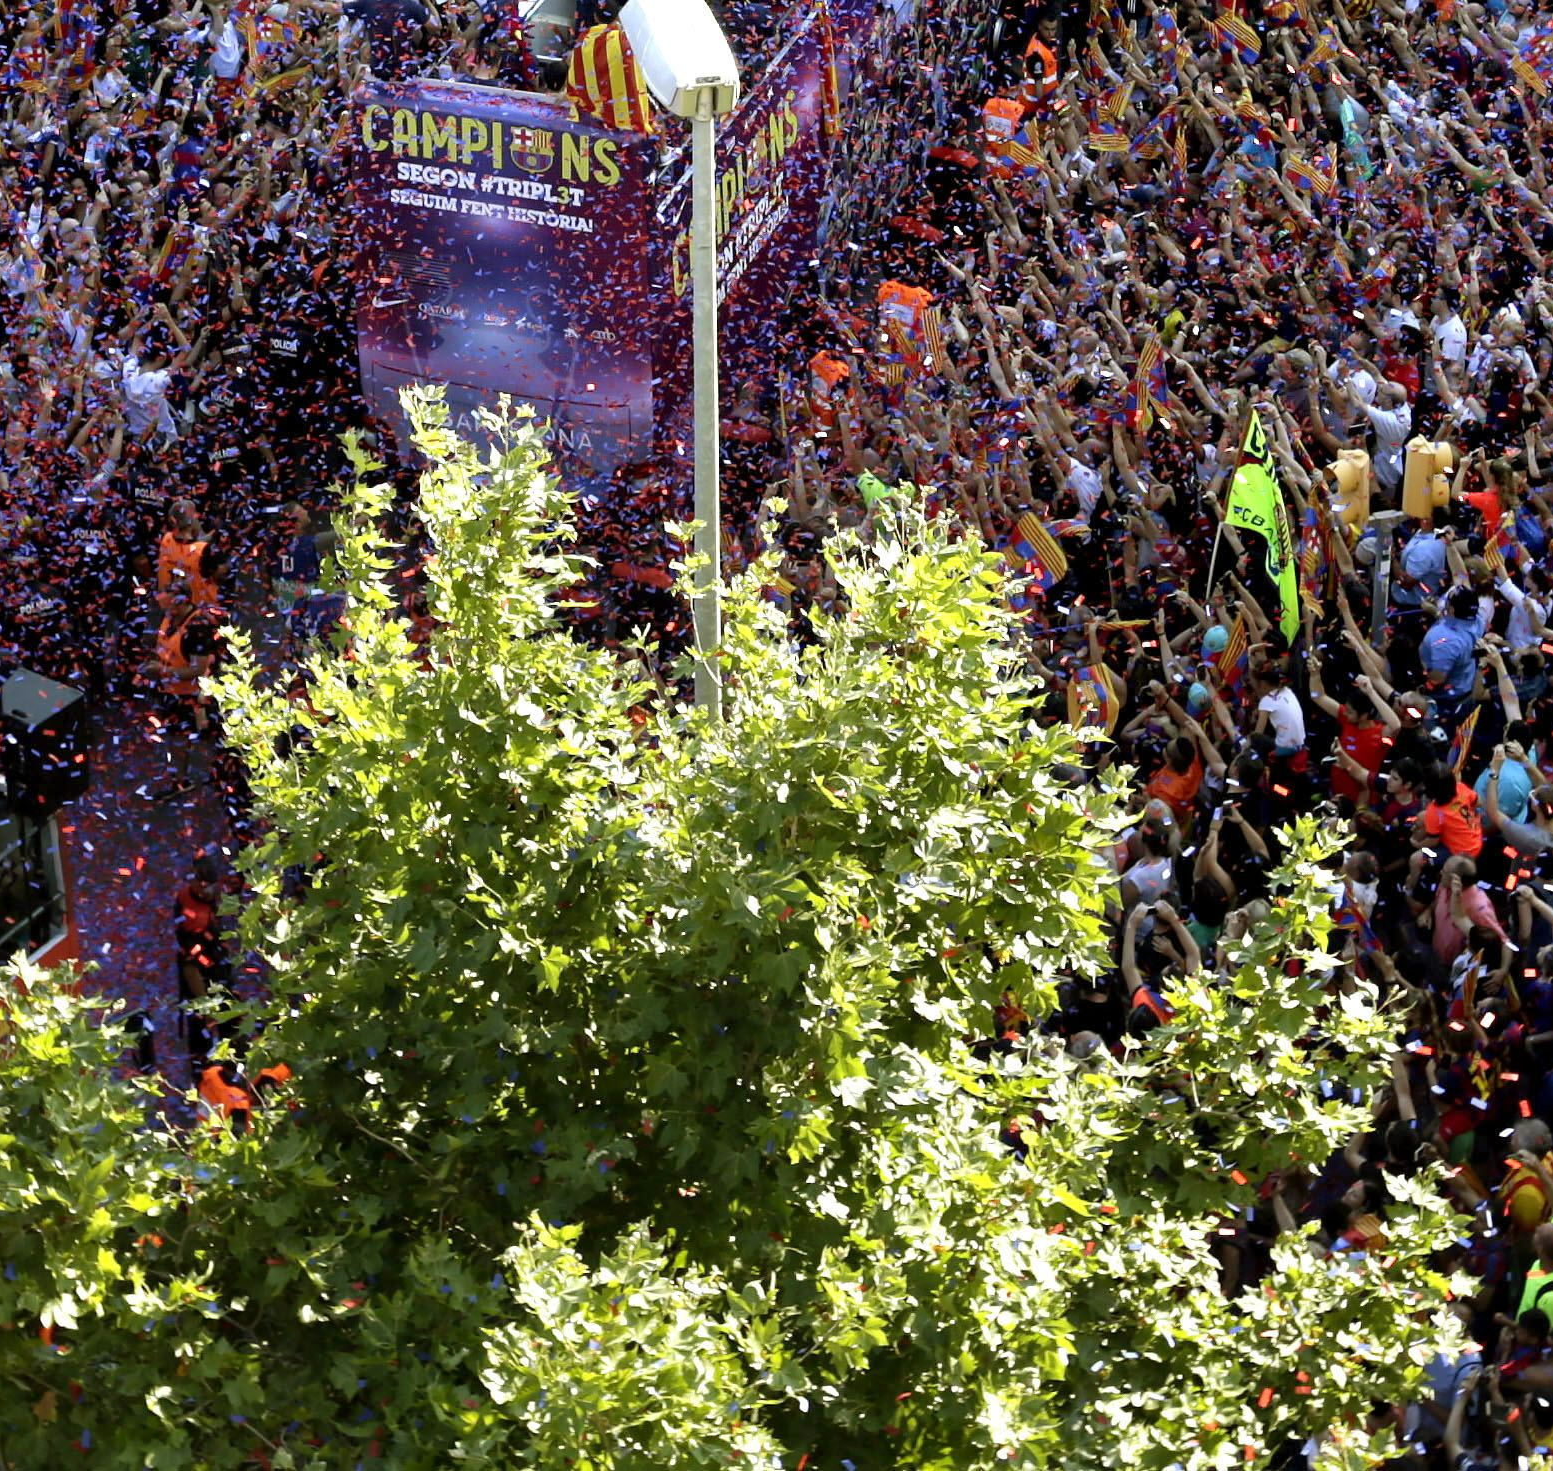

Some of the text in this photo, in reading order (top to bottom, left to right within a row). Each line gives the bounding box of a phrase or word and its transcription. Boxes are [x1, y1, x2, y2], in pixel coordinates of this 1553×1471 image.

[390, 188, 457, 214] SEGUIM
[460, 198, 505, 220] FENT
[397, 161, 585, 208] SEGON #TRIPL3T
